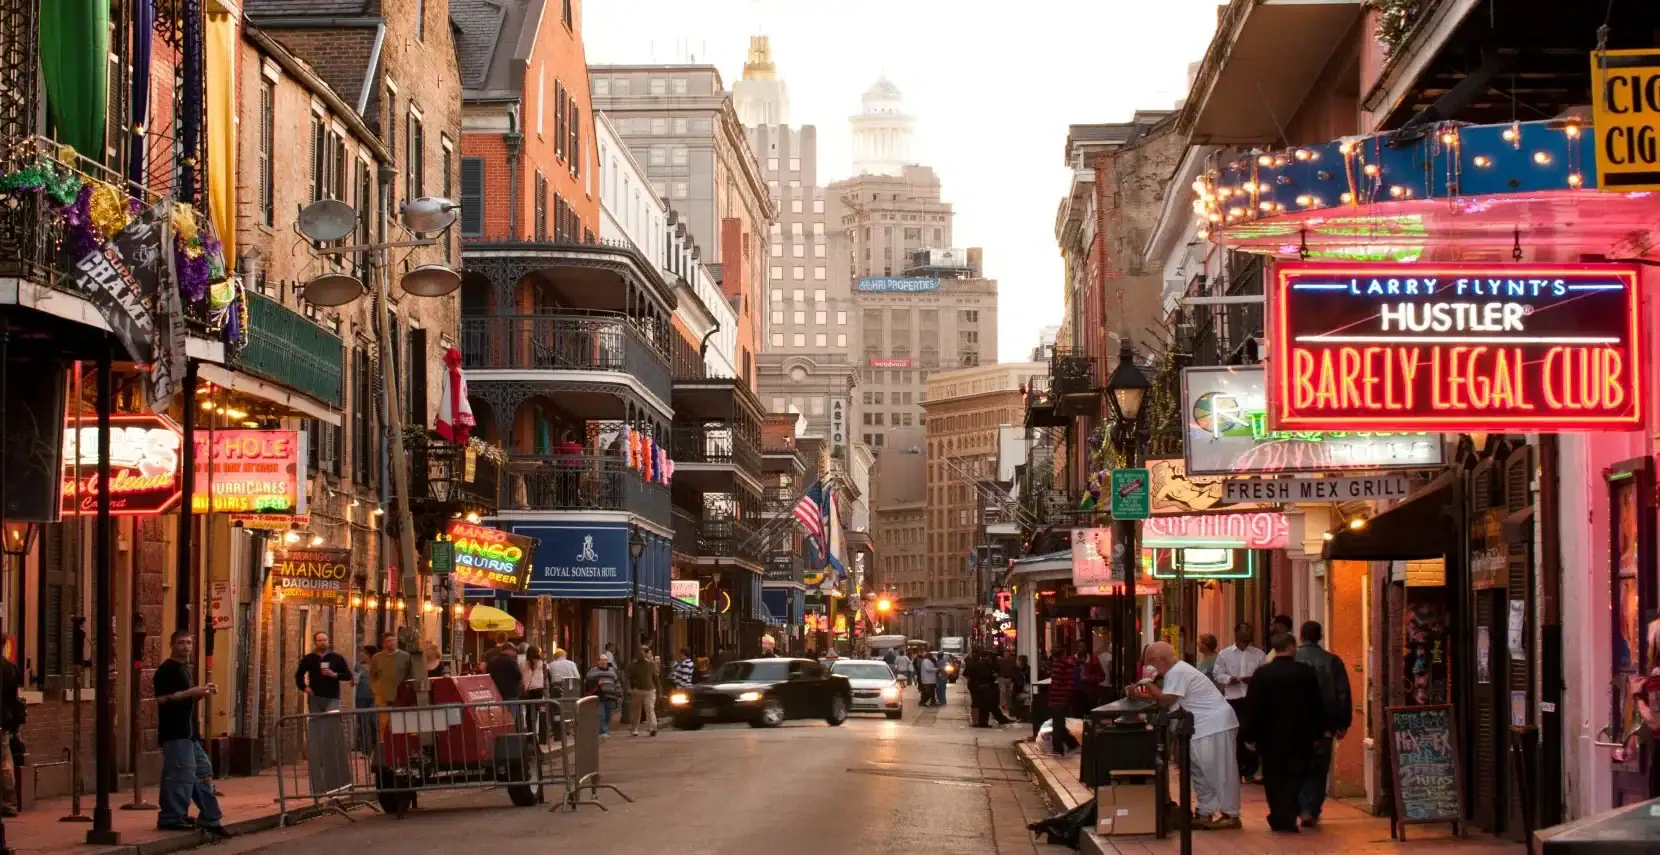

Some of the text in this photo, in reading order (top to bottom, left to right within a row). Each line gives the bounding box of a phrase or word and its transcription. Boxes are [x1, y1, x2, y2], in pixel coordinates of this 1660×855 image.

[104, 248, 143, 297] SUPER
[872, 279, 934, 291] HRI PROPERTIES
[1350, 278, 1566, 296] LARRY FLYNT'S
[1293, 346, 1625, 411] BARELY LEGAL CLUB
[225, 437, 289, 459] HOLE
[1227, 479, 1406, 499] FRESH MEX GRILL
[453, 524, 507, 542] MANGO
[293, 552, 332, 562] MANGO
[455, 538, 523, 562] ANGO
[280, 561, 346, 579] MANGO
[456, 554, 514, 573] IQUIRIS
[544, 567, 617, 578] ROYAL SONESTA HOTEL
[282, 578, 340, 590] DAIQUIRIS
[487, 571, 517, 585] BEER
